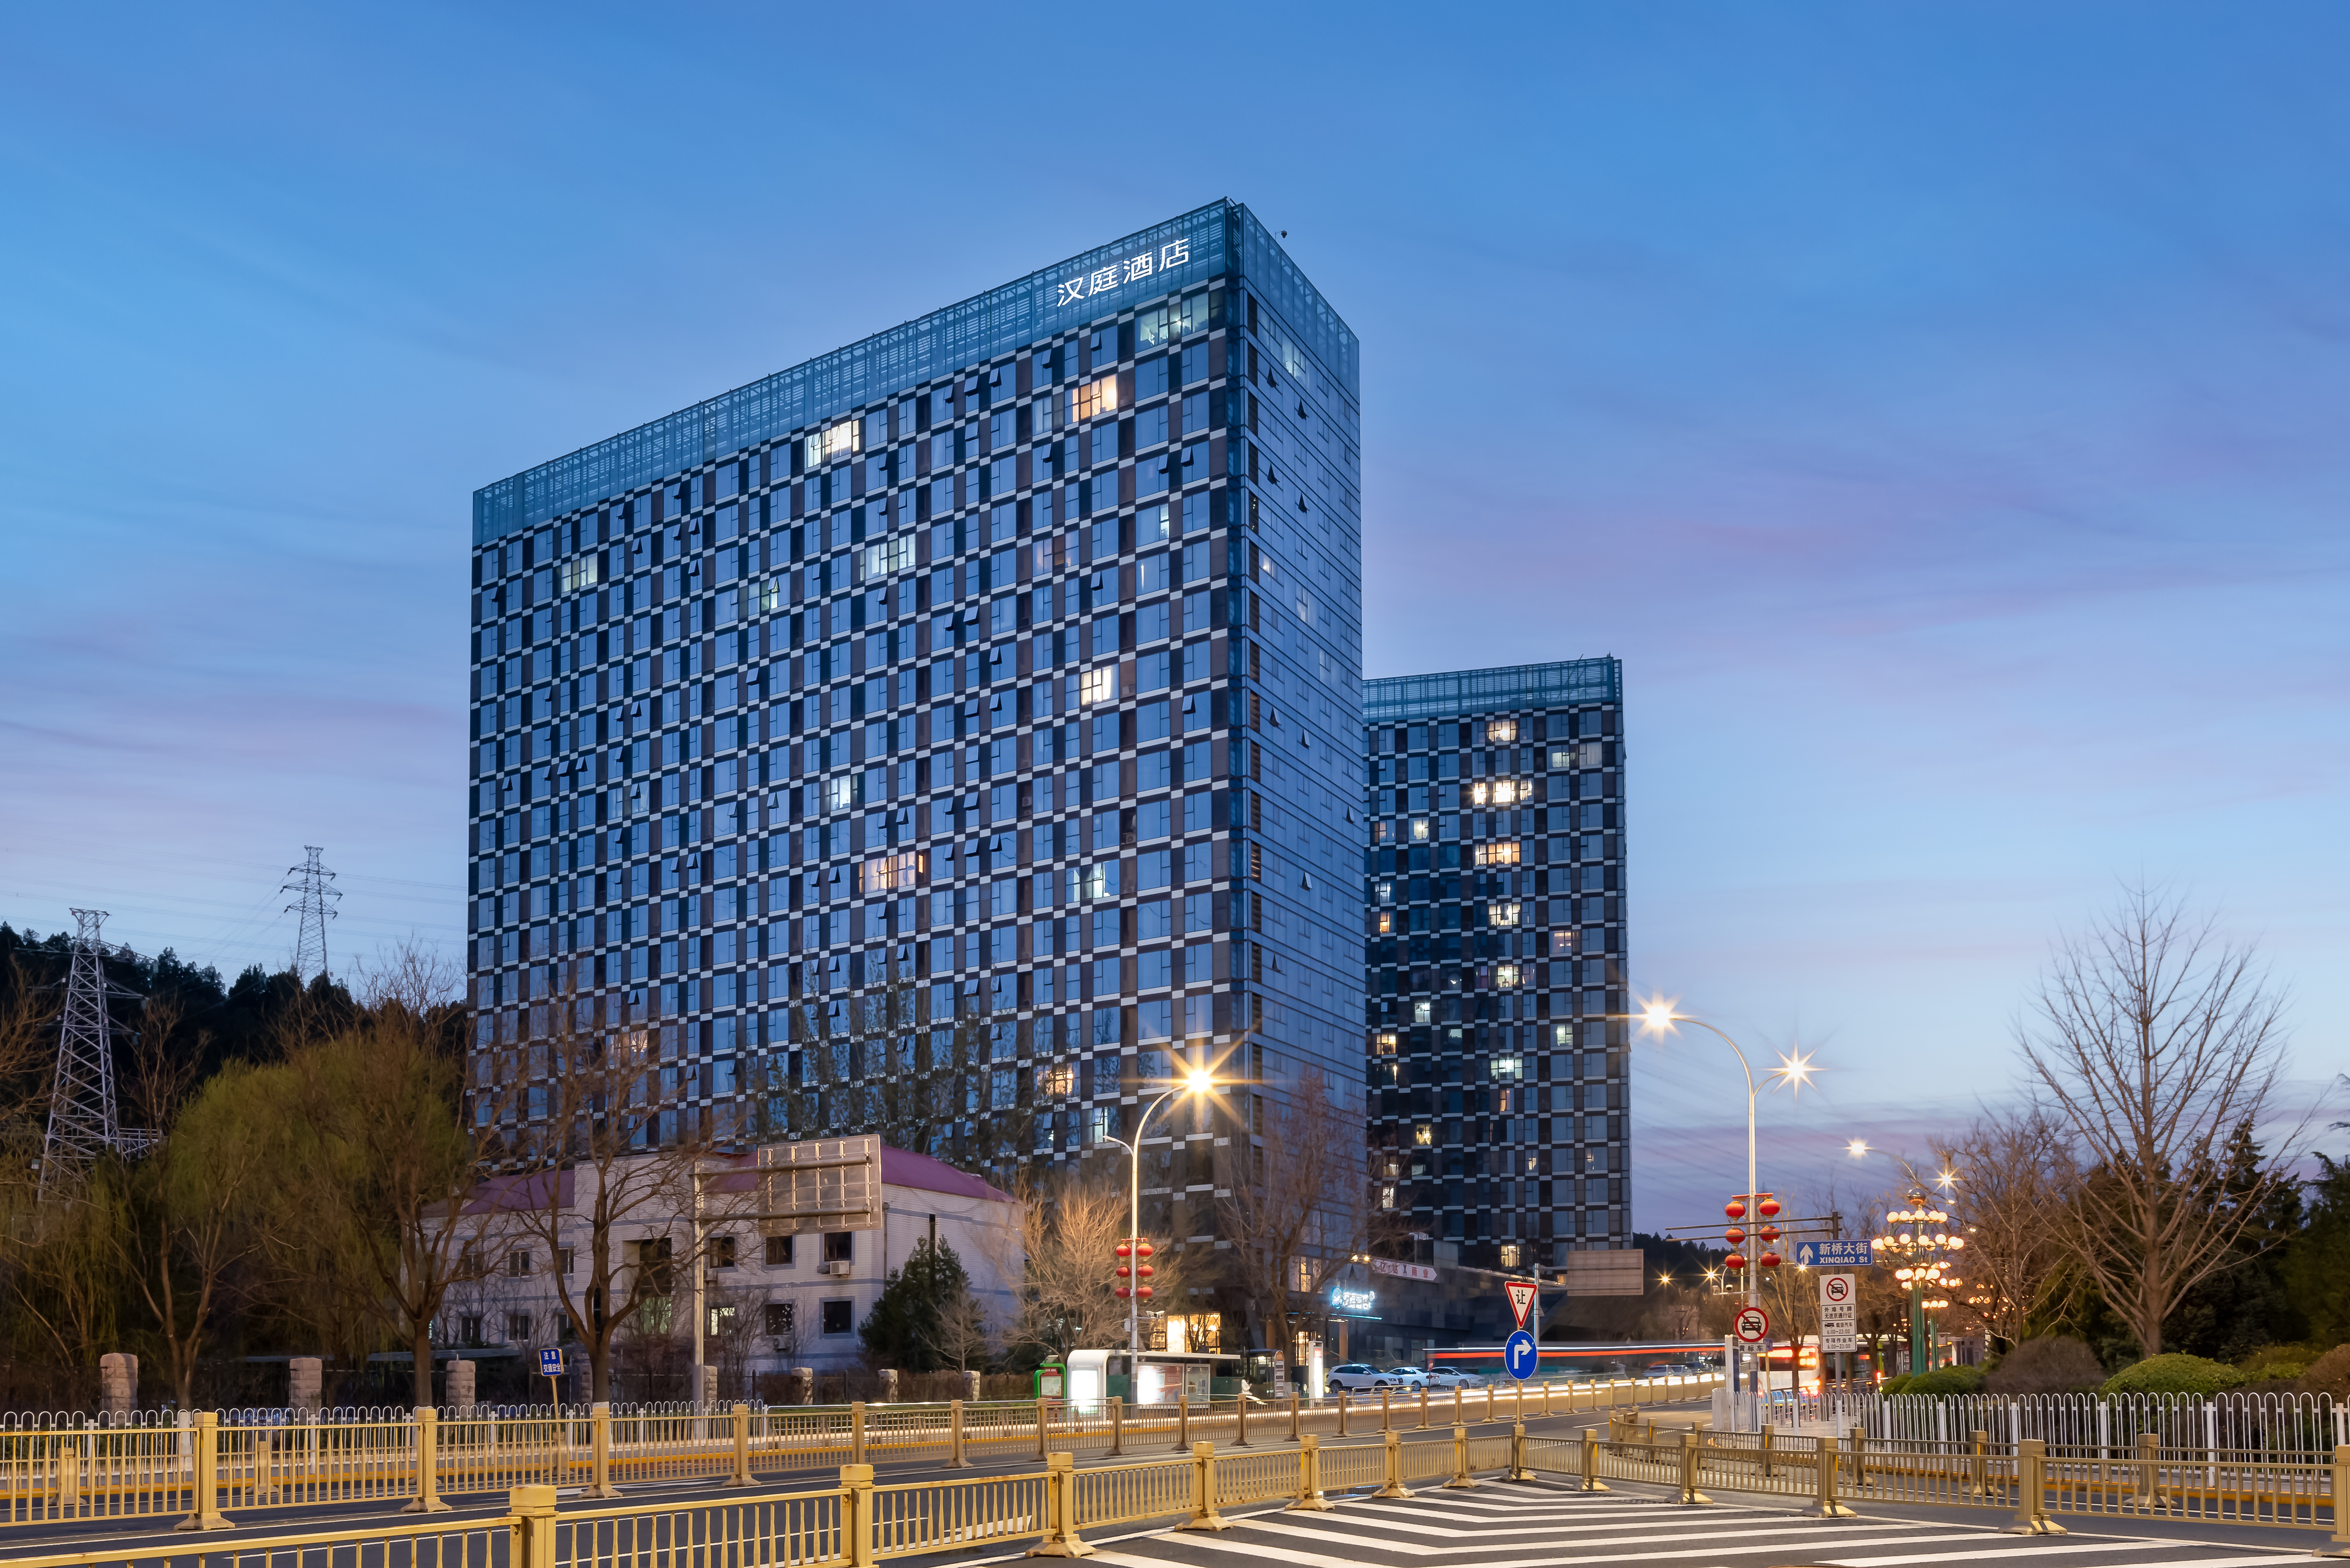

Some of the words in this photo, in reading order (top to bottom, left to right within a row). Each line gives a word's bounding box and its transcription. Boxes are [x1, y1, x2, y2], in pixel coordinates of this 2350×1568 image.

[1057, 237, 1189, 307] 汉庭酒店
[1819, 1243, 1868, 1255] 新桥大街
[1516, 1290, 1526, 1304] 让
[543, 1363, 561, 1372] 交通安全
